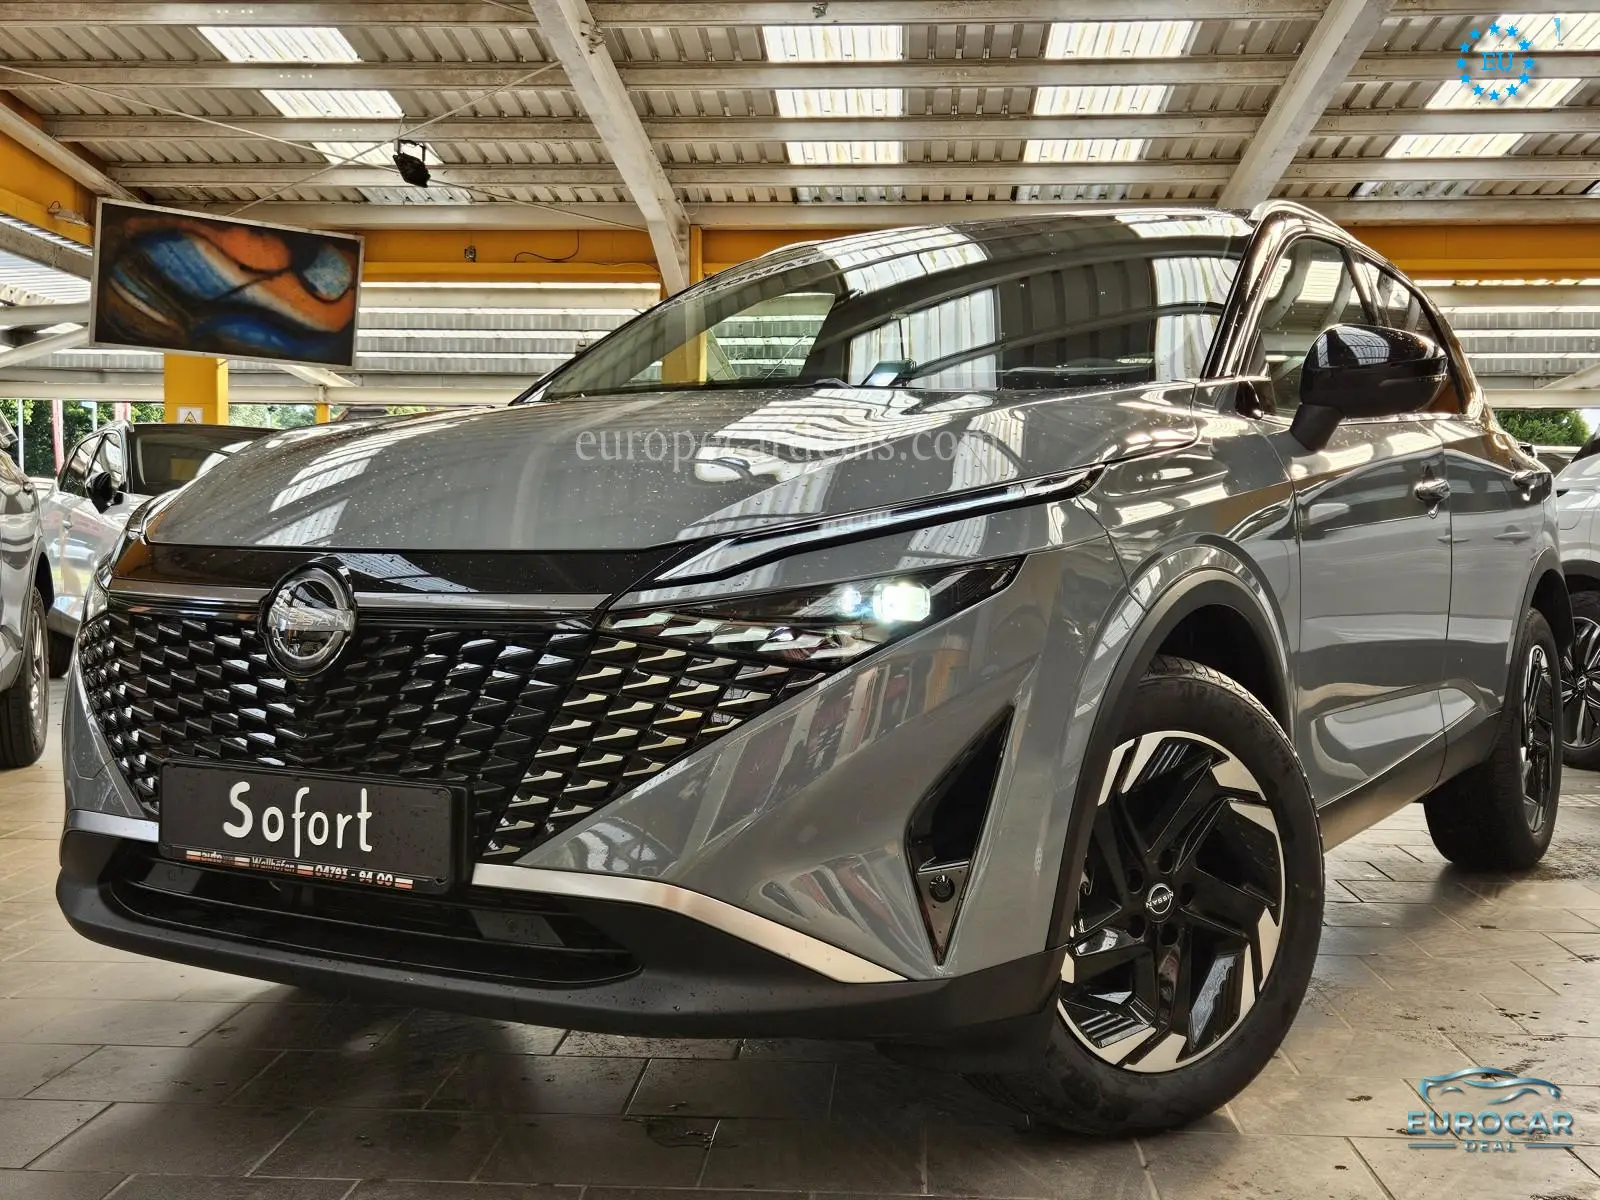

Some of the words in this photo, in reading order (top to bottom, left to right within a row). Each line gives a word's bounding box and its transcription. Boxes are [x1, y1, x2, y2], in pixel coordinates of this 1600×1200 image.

[267, 609, 352, 628] NSSAN
[223, 781, 373, 858] Sofort
[1145, 891, 1174, 908] NISSAN
